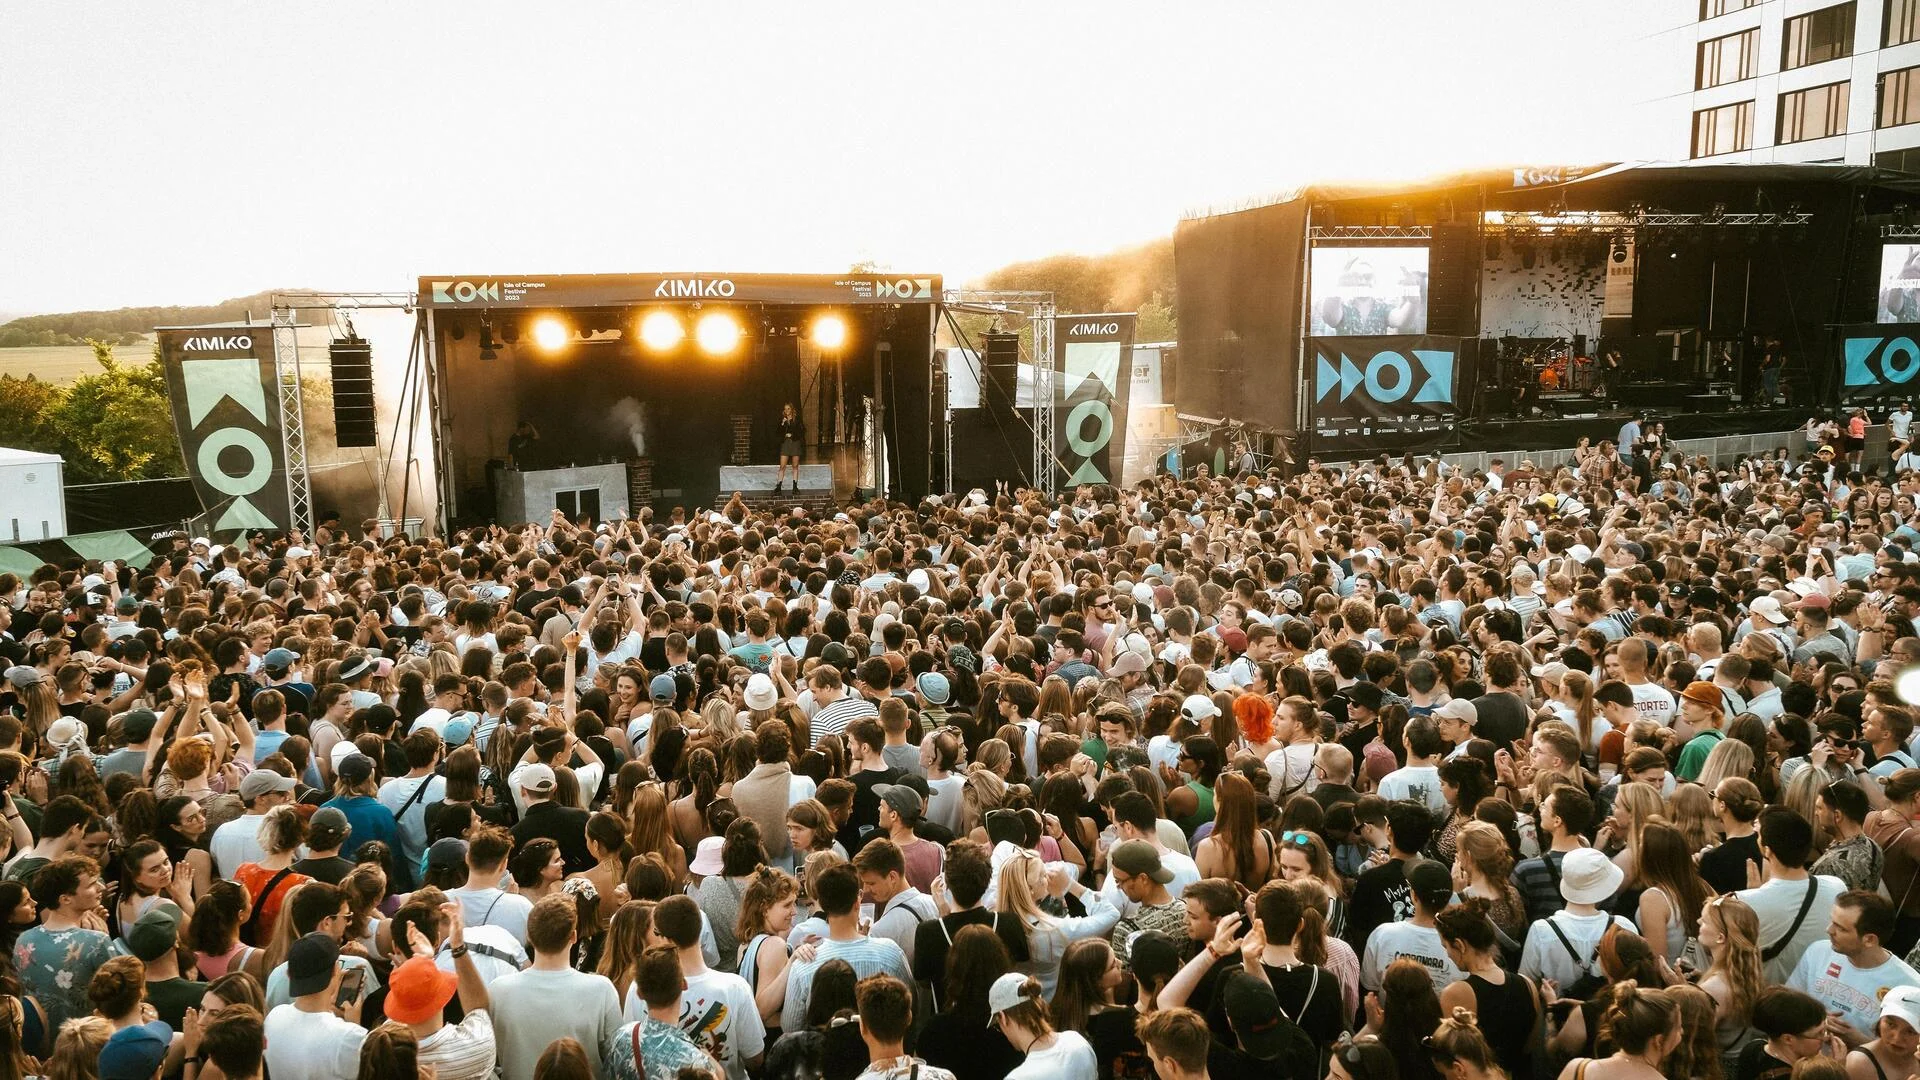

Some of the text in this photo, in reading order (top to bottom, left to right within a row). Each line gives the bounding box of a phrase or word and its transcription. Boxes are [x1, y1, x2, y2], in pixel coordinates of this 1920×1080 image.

[522, 281, 546, 289] Campus
[655, 279, 735, 297] KIMIKO
[1069, 323, 1119, 335] KIMIKO
[183, 336, 252, 351] KIMIKO
